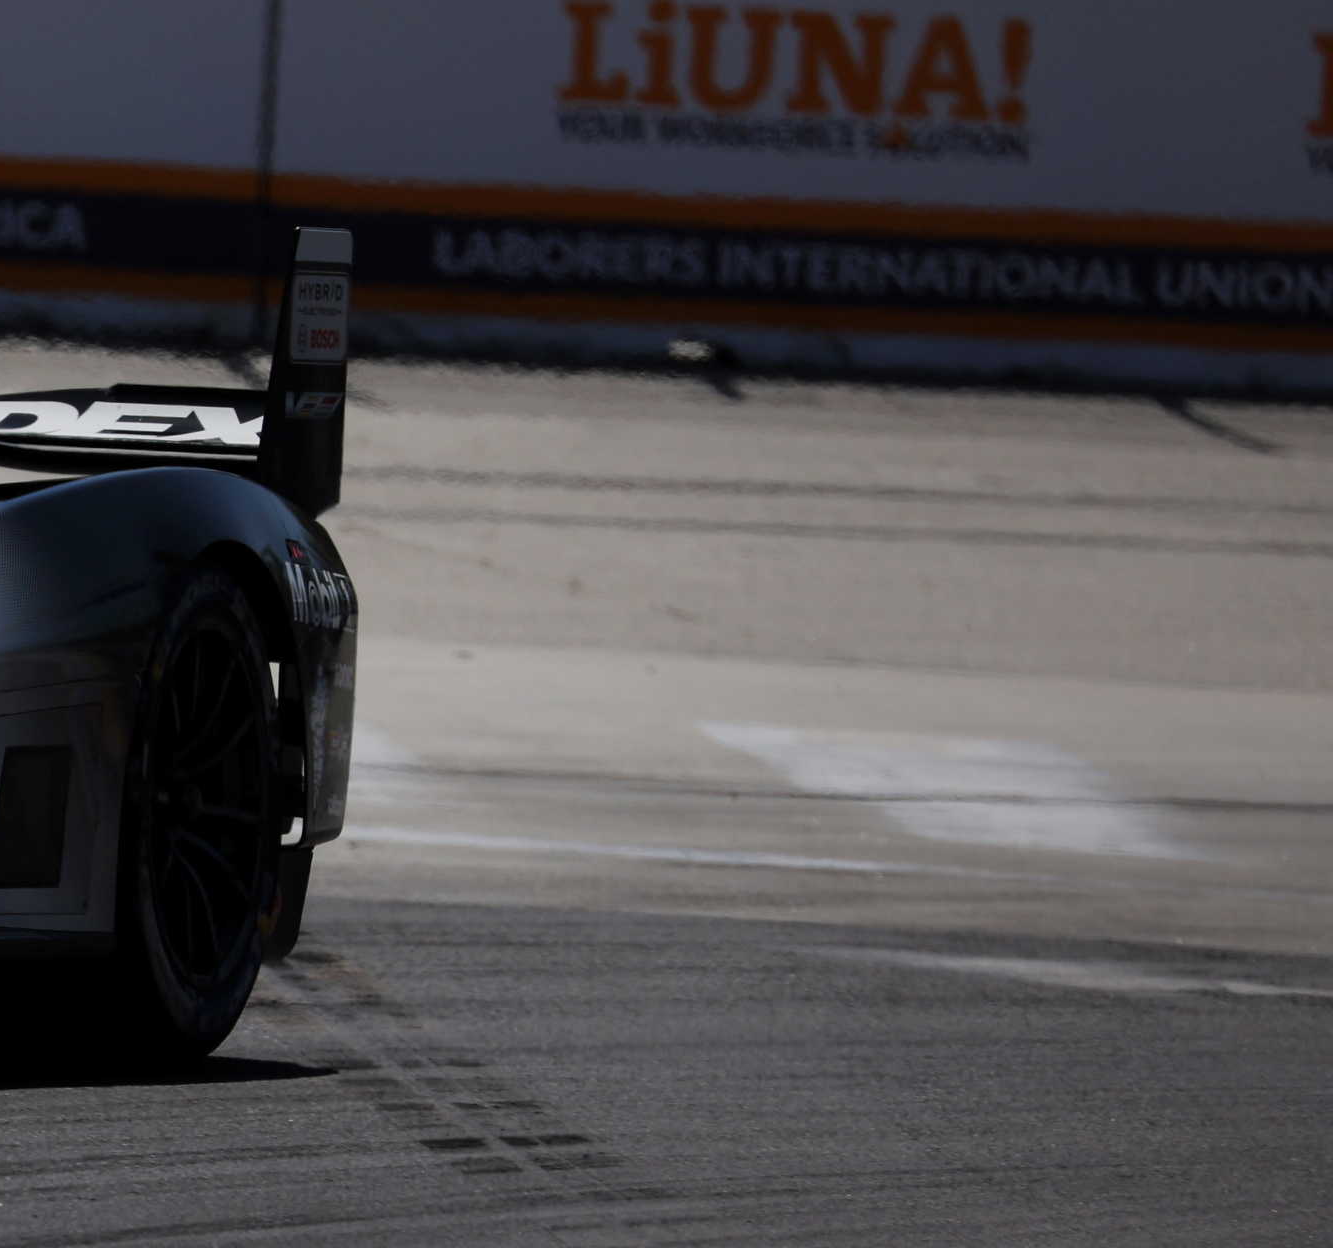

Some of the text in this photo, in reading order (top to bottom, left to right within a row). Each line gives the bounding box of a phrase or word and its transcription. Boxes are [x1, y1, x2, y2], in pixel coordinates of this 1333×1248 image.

[559, 1, 1032, 124] LiUNA!
[298, 280, 344, 302] HYBRID
[431, 225, 707, 286] LABORERS
[716, 239, 1146, 308] INTERNATIONAL
[310, 328, 340, 349] BOSCH
[284, 561, 341, 630] Mobil
